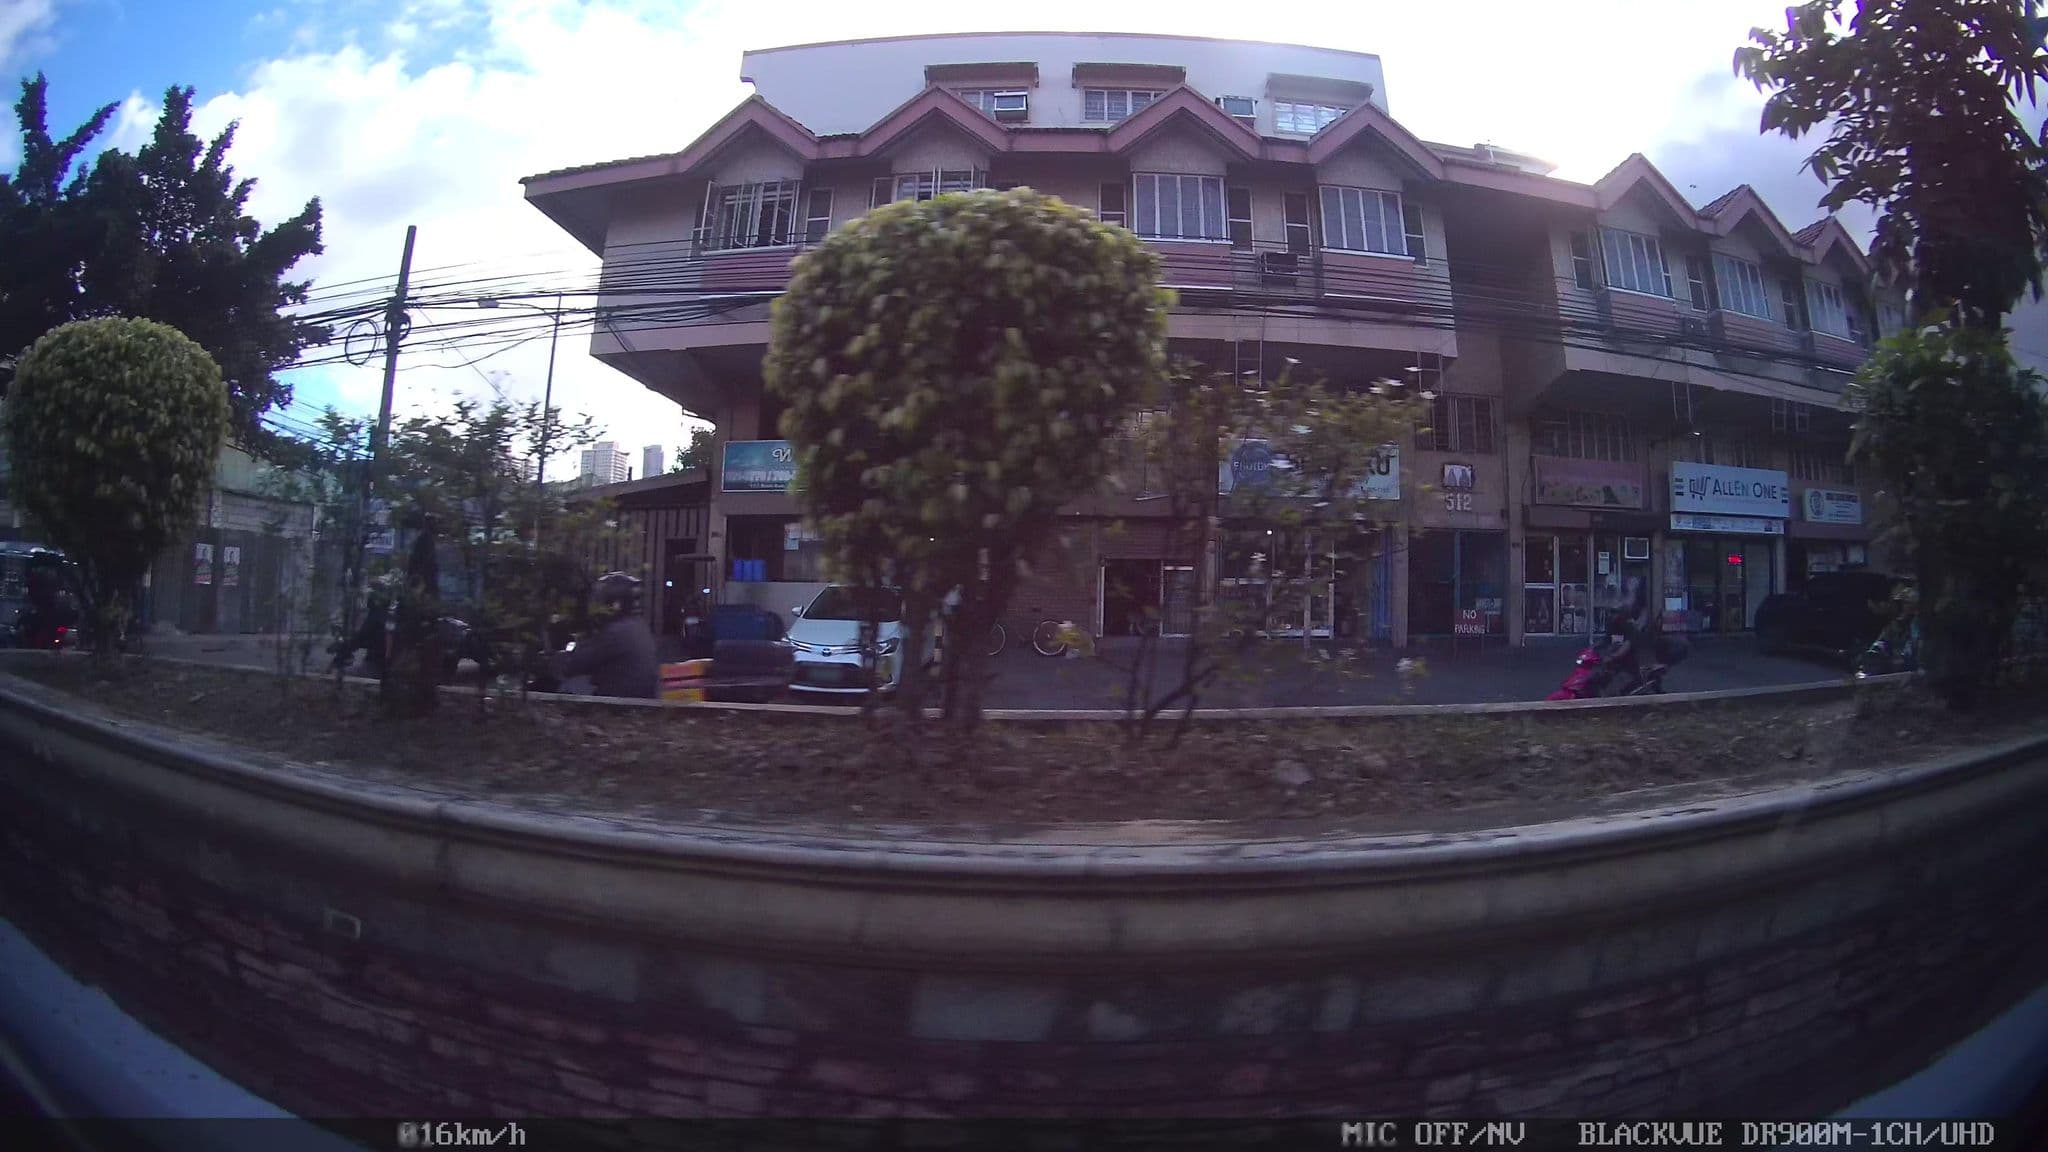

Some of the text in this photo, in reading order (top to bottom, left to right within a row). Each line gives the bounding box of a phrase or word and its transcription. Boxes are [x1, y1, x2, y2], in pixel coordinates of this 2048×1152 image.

[1713, 479, 1777, 499] ALLEN ONE
[1445, 493, 1472, 511] 512
[1463, 609, 1477, 619] NO
